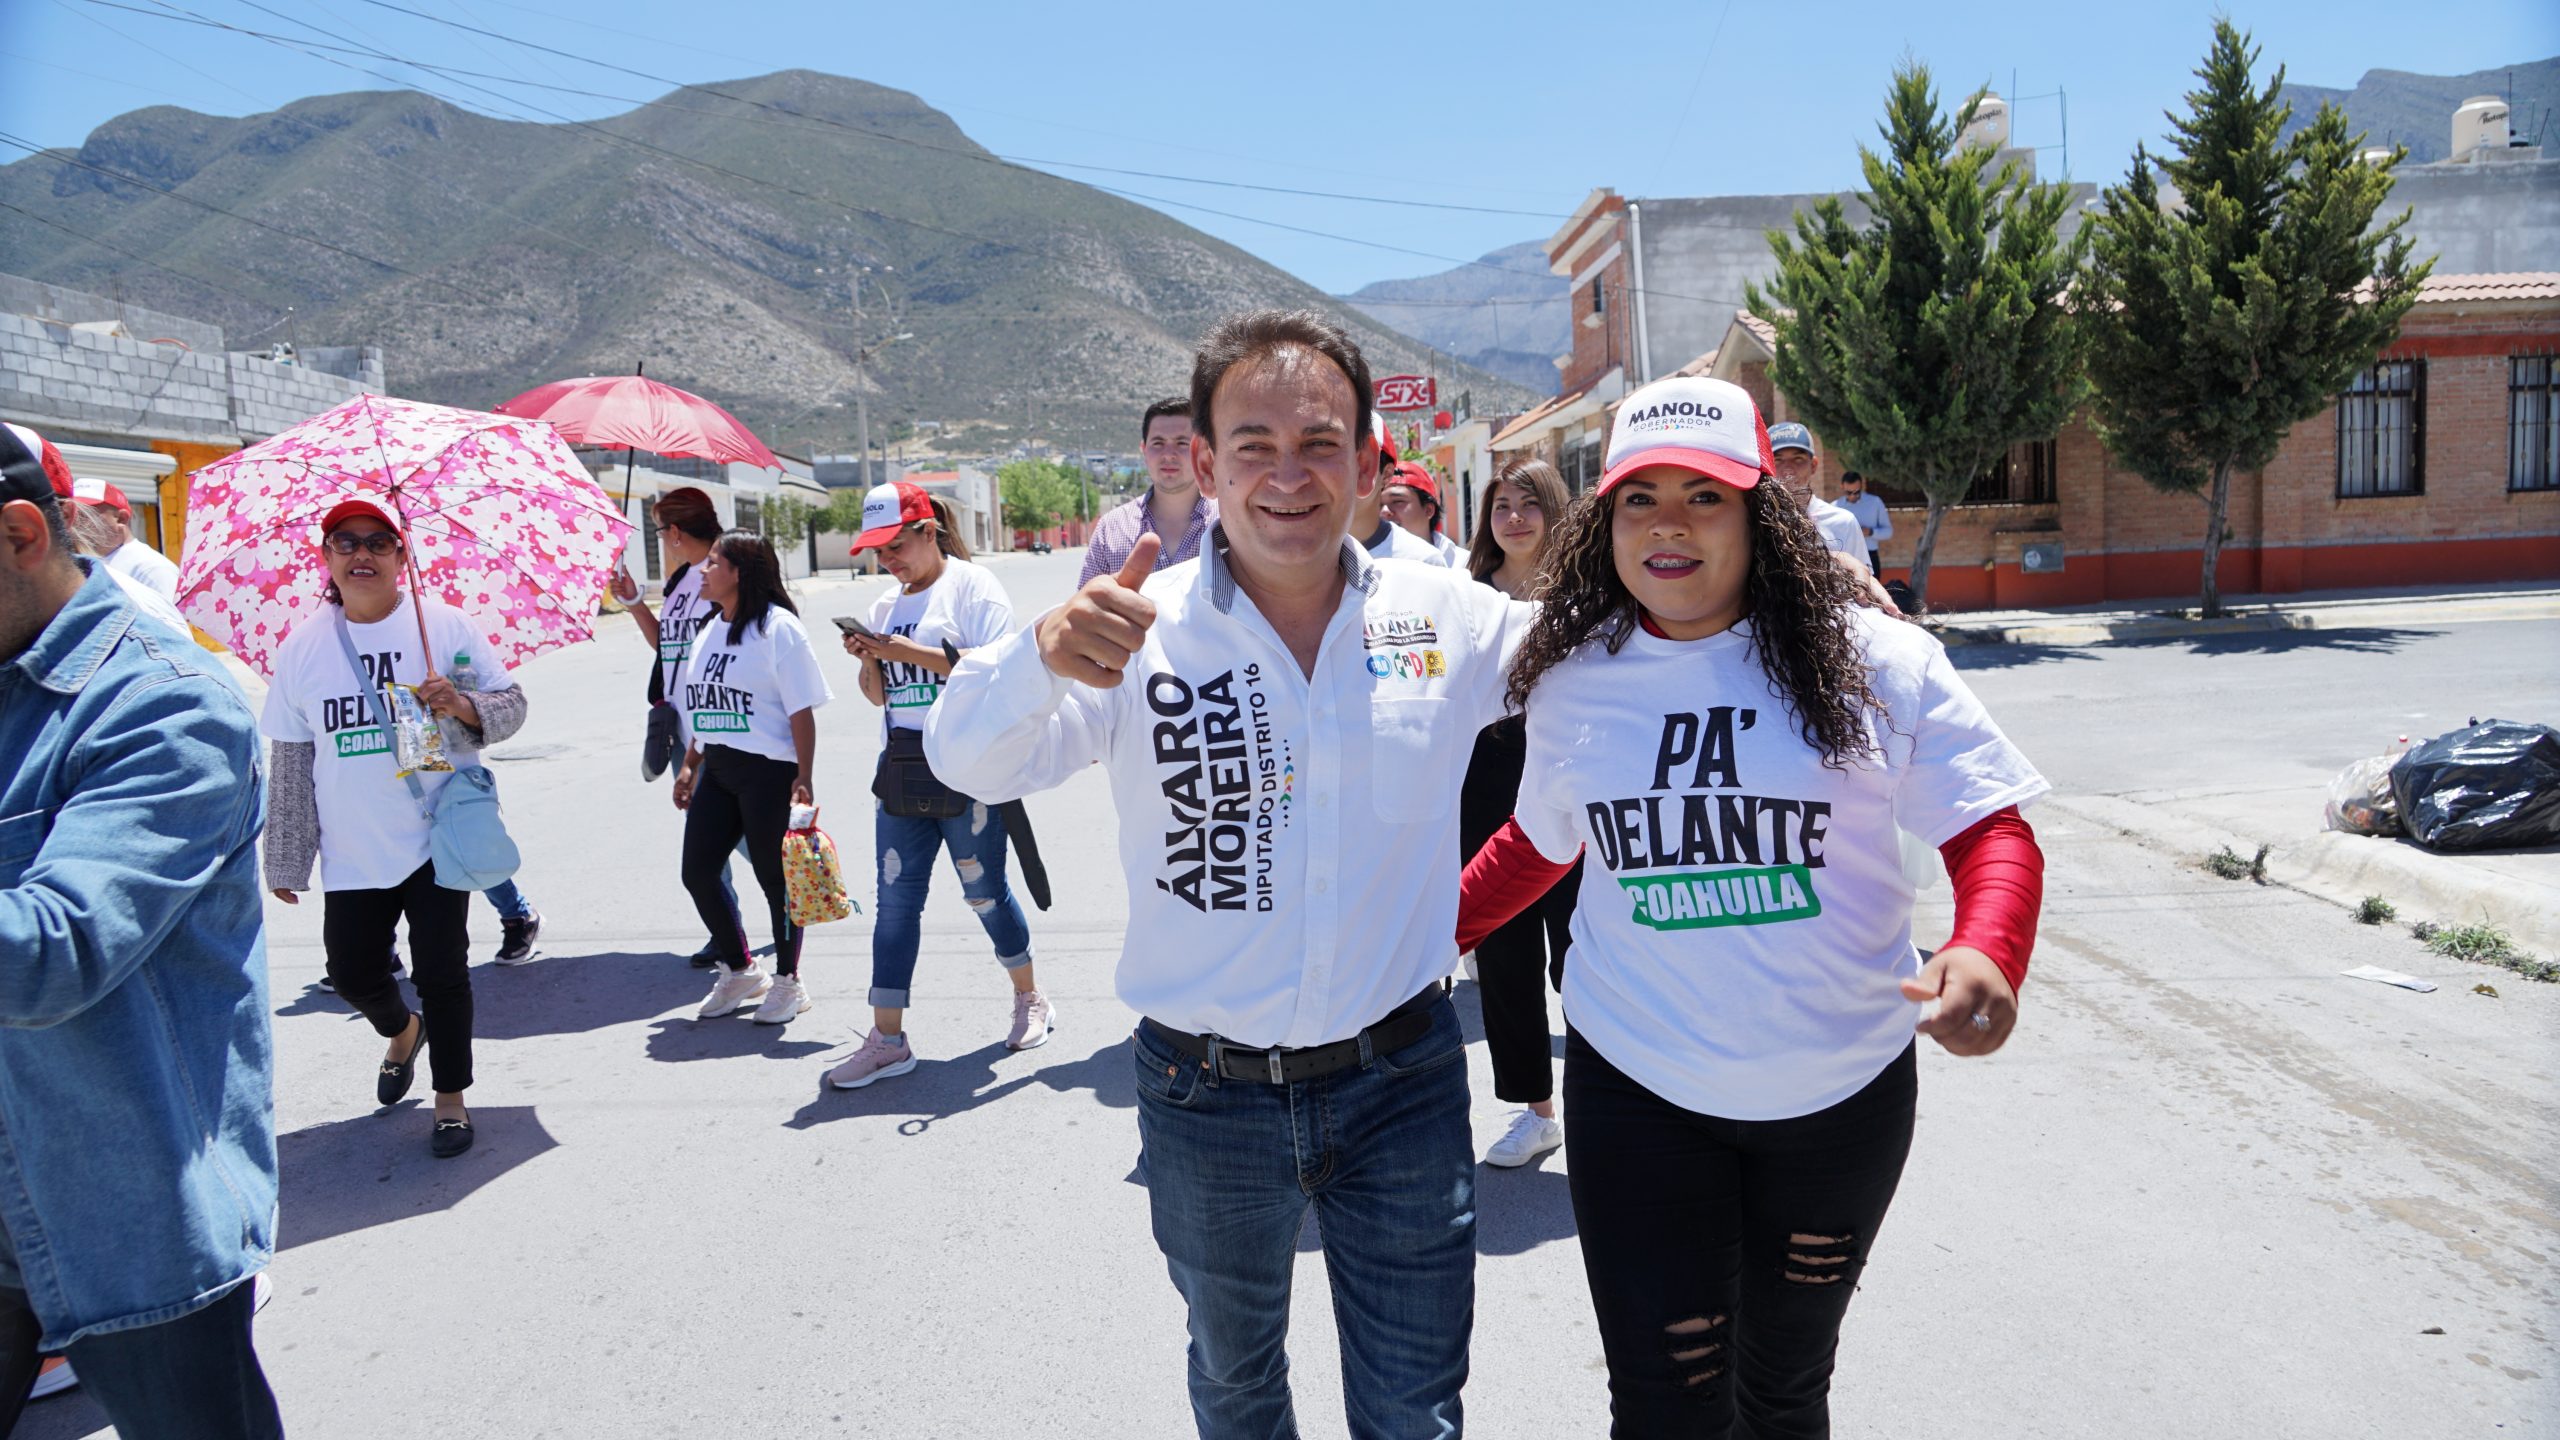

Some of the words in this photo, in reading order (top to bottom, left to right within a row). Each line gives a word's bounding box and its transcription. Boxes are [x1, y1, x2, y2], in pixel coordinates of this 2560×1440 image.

[1628, 402, 1722, 427] MANOLO
[1633, 417, 1711, 432] GOBERNADOR
[1363, 615, 1434, 638] ALIANZA
[703, 653, 737, 683] PA'
[1246, 662, 1260, 688] 16
[340, 732, 387, 753] COAH
[1249, 693, 1277, 792] DISTRITO
[1649, 706, 1757, 790] PA'
[1146, 671, 1207, 913] ÁLVARO
[1198, 670, 1251, 911] MOREIRA
[1257, 797, 1273, 912] DIPUTADO
[1585, 794, 1831, 871] DELANTE
[1625, 872, 1809, 922] COAHUILA
